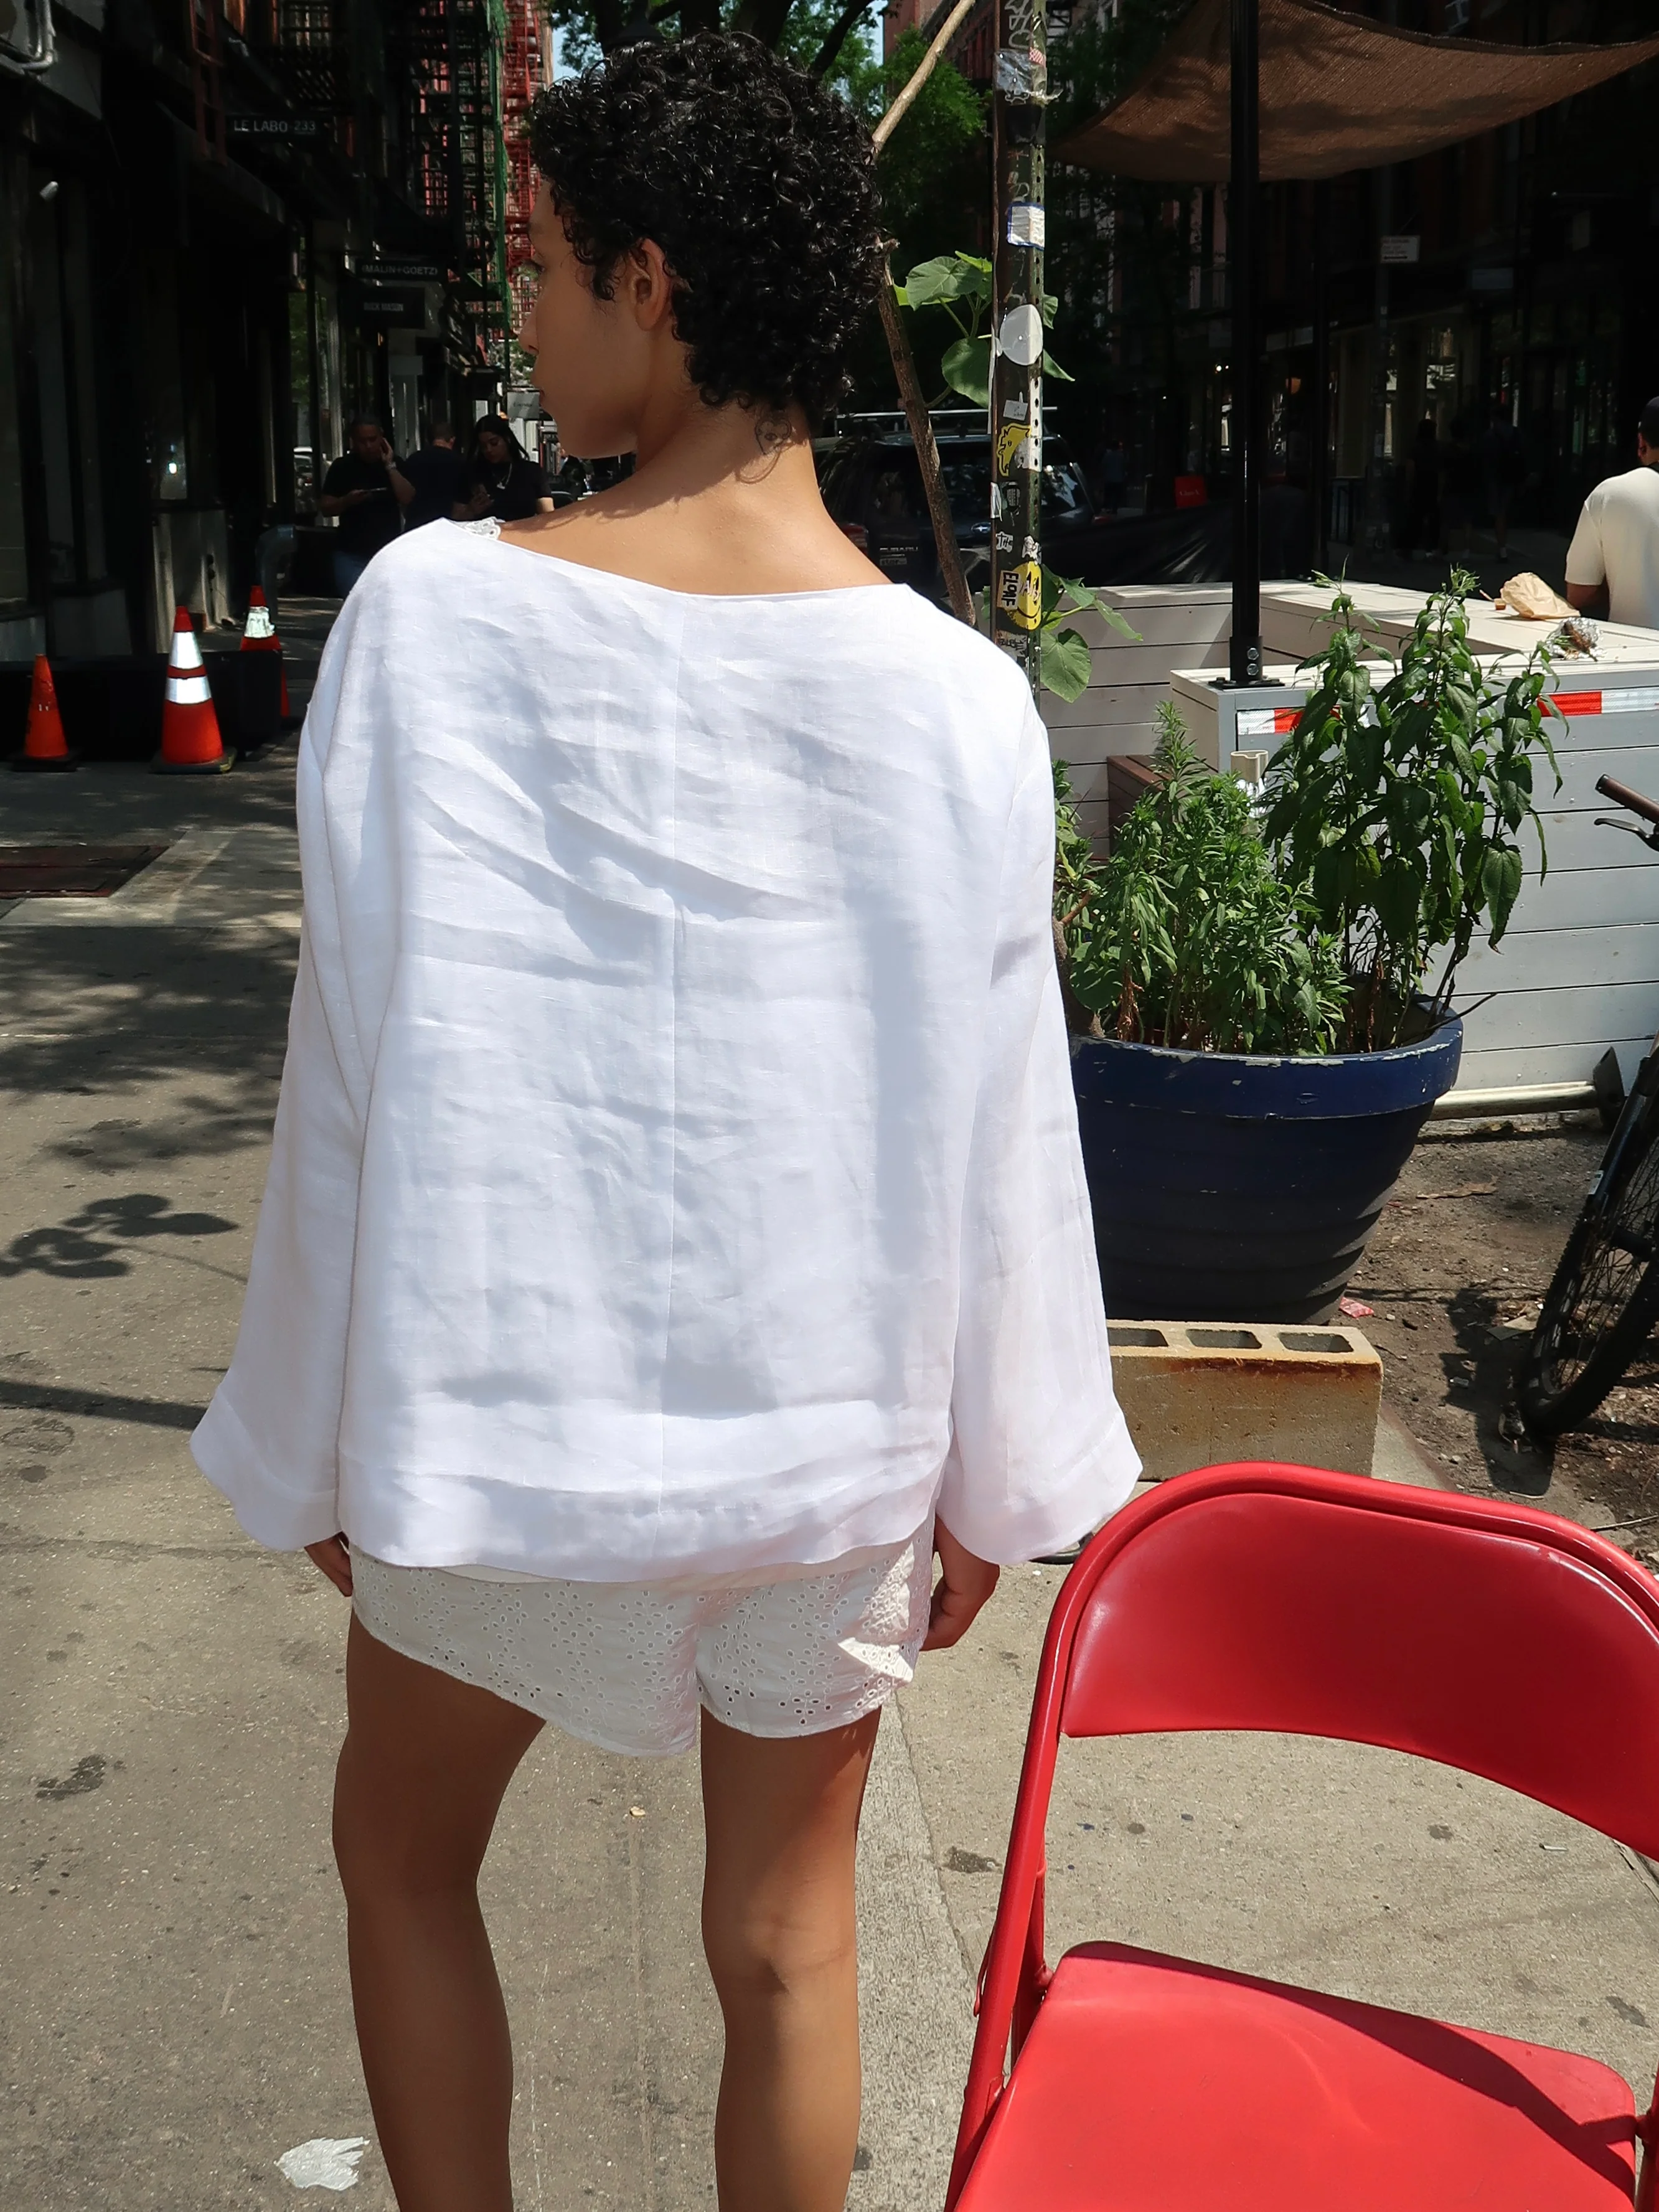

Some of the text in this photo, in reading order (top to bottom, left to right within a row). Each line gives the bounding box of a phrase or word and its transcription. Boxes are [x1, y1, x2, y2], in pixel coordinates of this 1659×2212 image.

[234, 120, 316, 133] LE LABO 233
